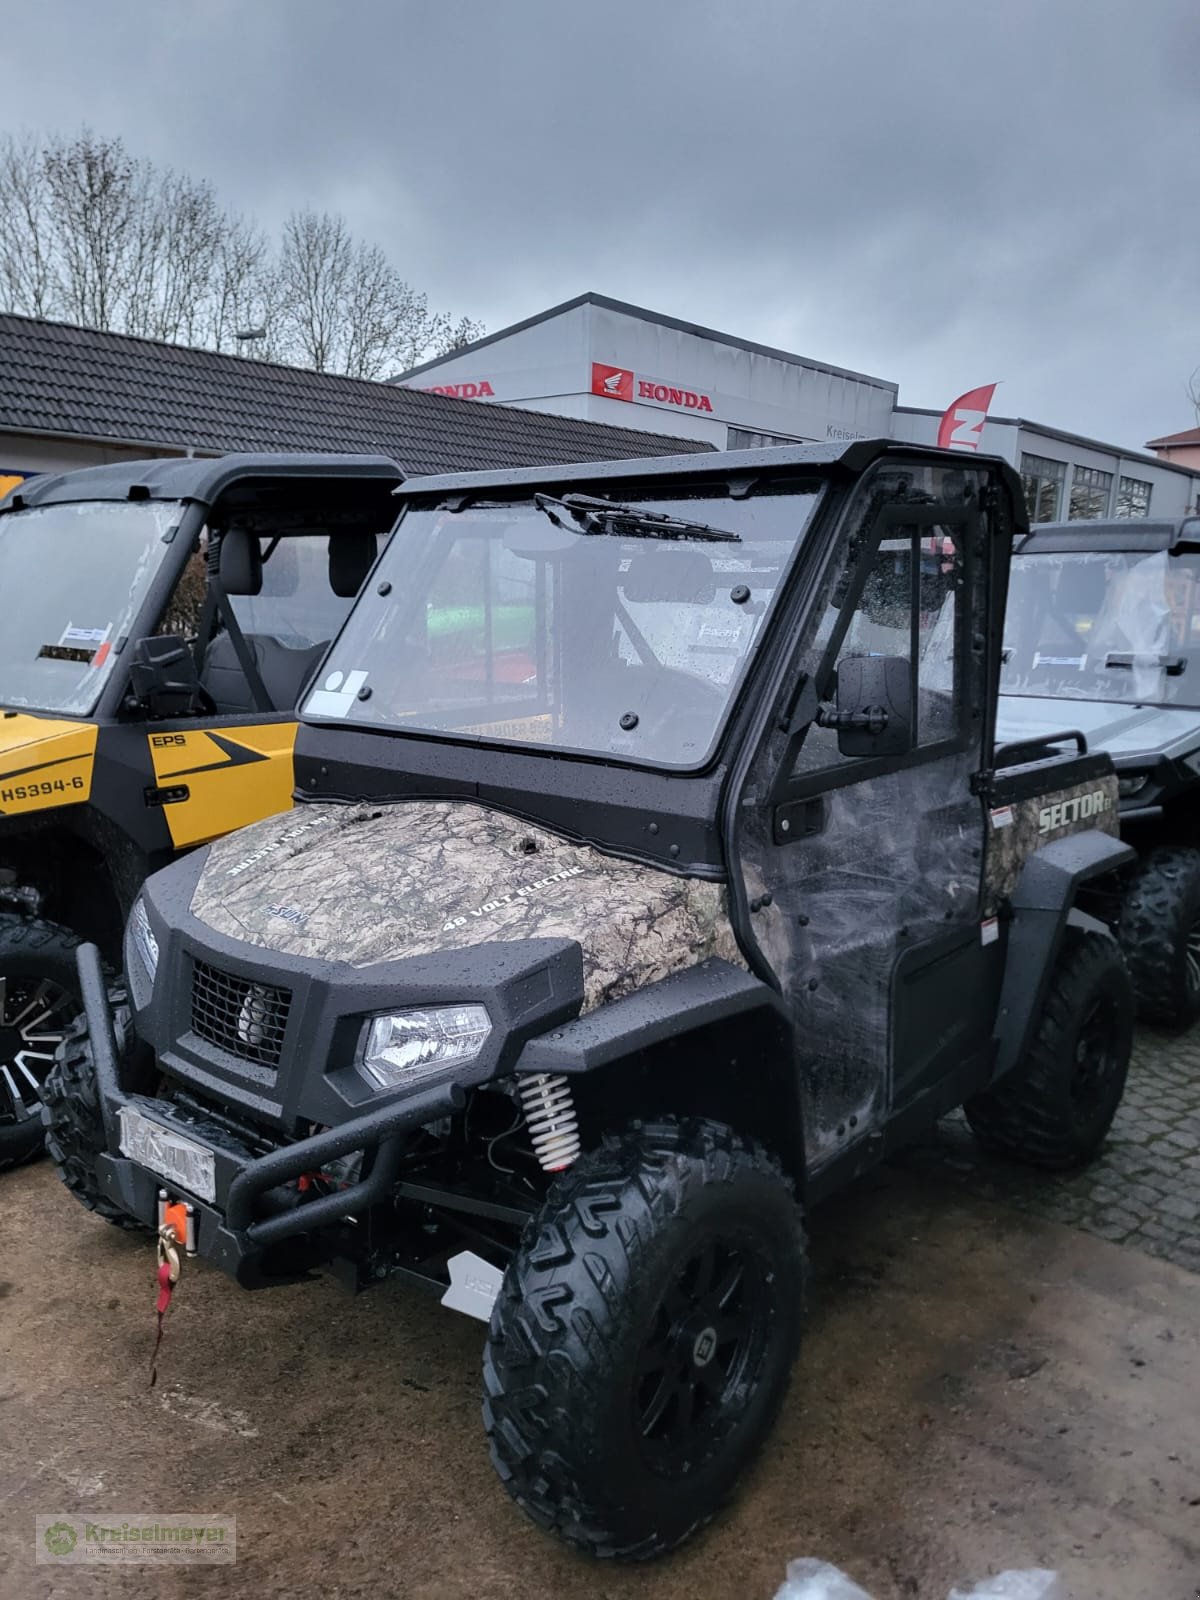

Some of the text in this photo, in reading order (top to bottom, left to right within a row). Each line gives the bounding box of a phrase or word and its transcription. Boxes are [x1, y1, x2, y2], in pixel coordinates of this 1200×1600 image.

[422, 381, 495, 400] ONDA
[638, 380, 713, 412] HONDA
[152, 734, 186, 747] EPS
[1, 776, 84, 801] HS394-6
[1039, 790, 1105, 834] SECTOR
[442, 865, 585, 932] 48 VOLT ELECTRIC
